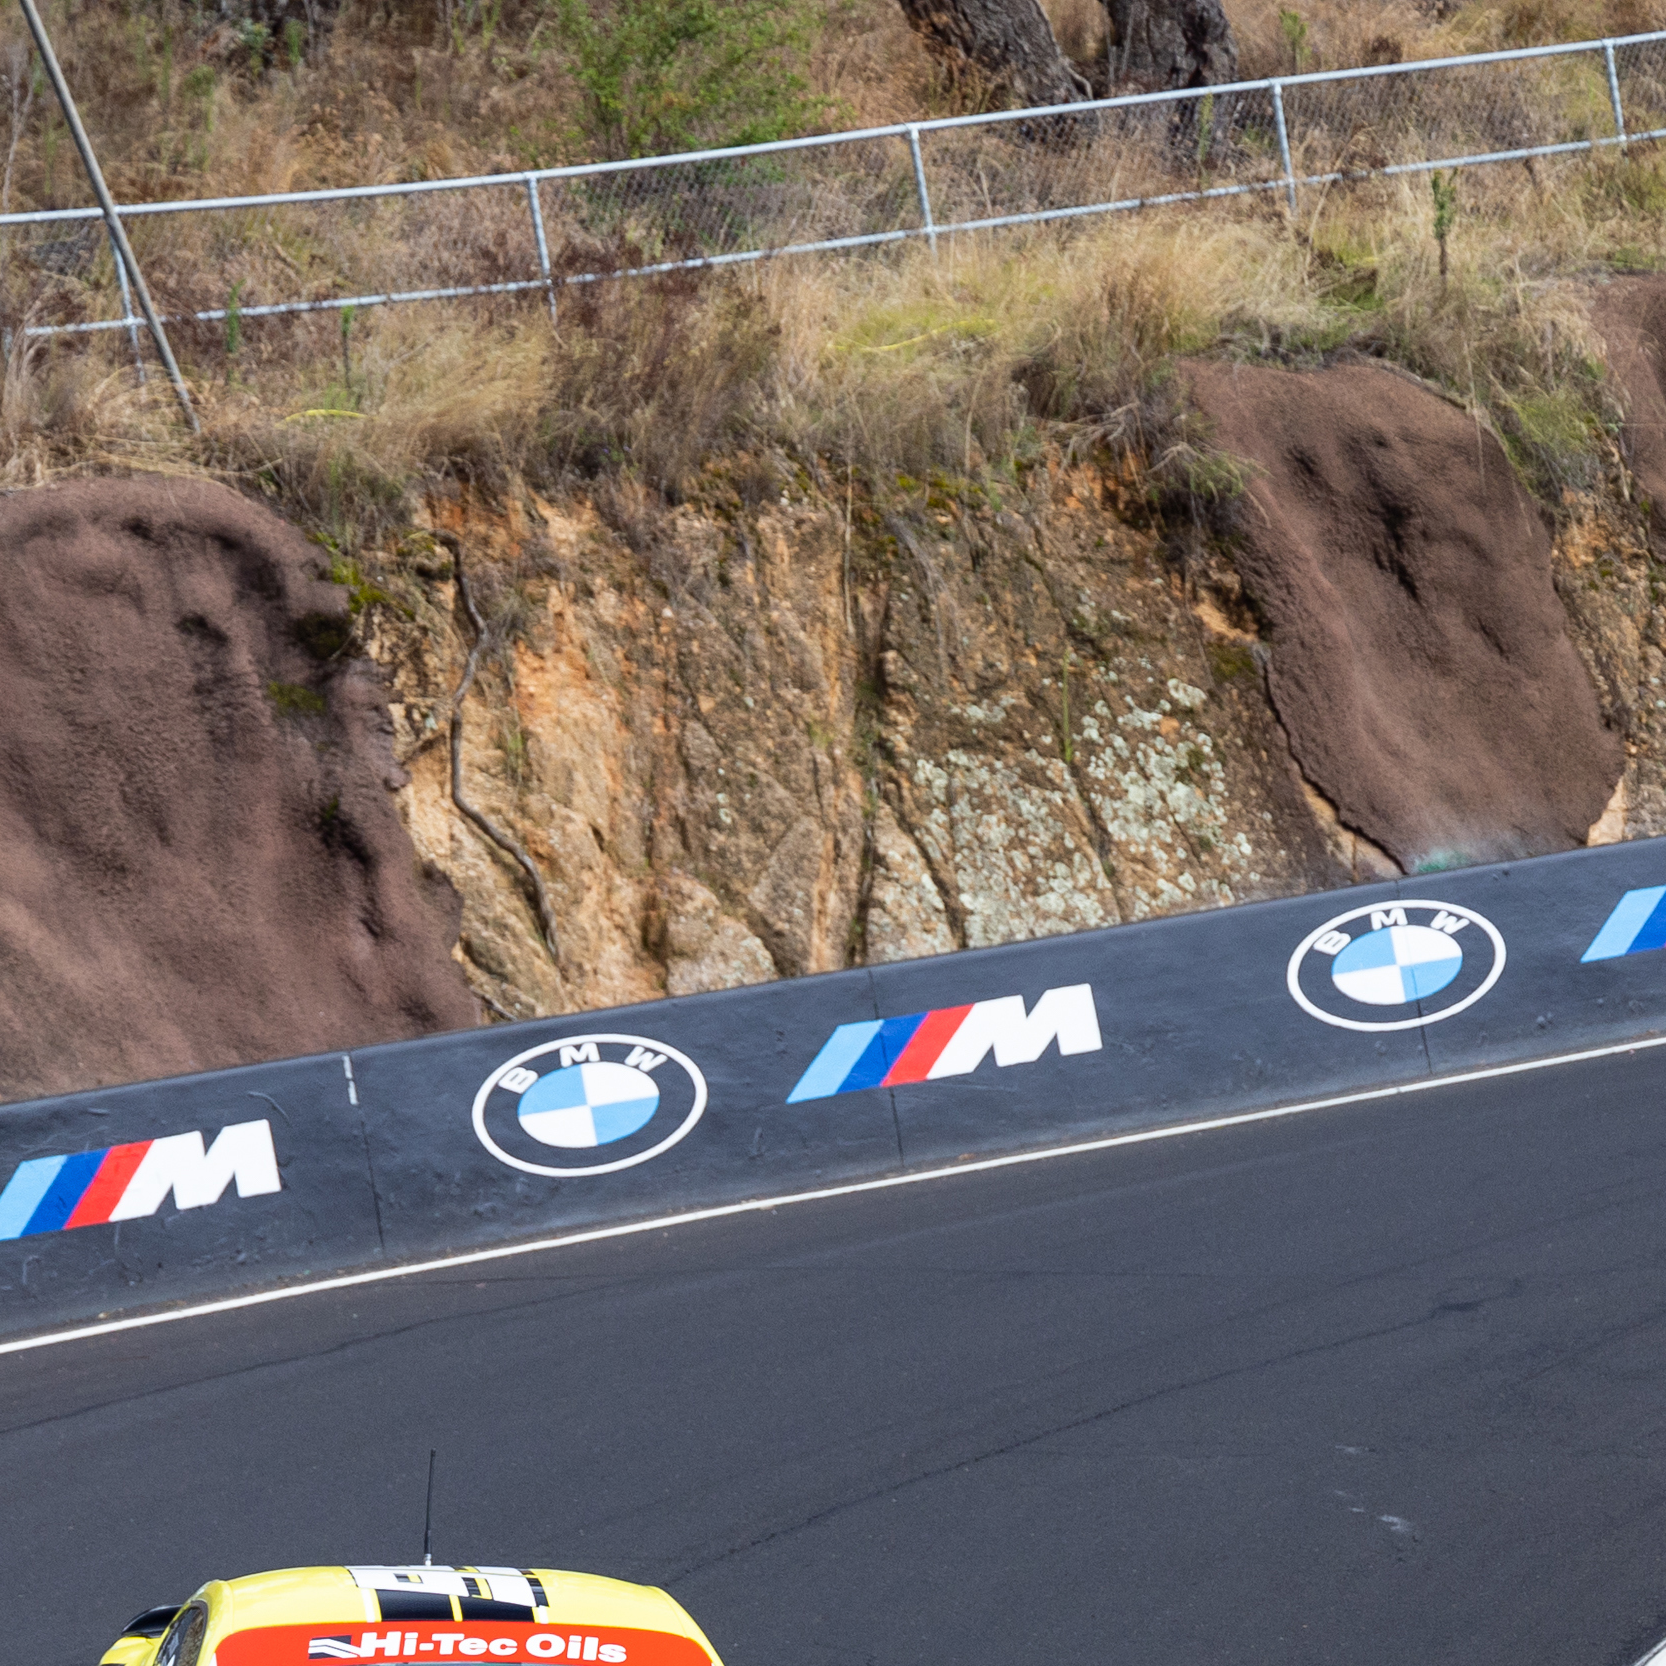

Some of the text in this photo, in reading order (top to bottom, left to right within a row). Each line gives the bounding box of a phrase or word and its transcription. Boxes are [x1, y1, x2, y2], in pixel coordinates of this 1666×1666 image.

[1314, 907, 1470, 956] BMW
[498, 1043, 668, 1094] BMW
[359, 1631, 627, 1663] Hi-Tec Oils
